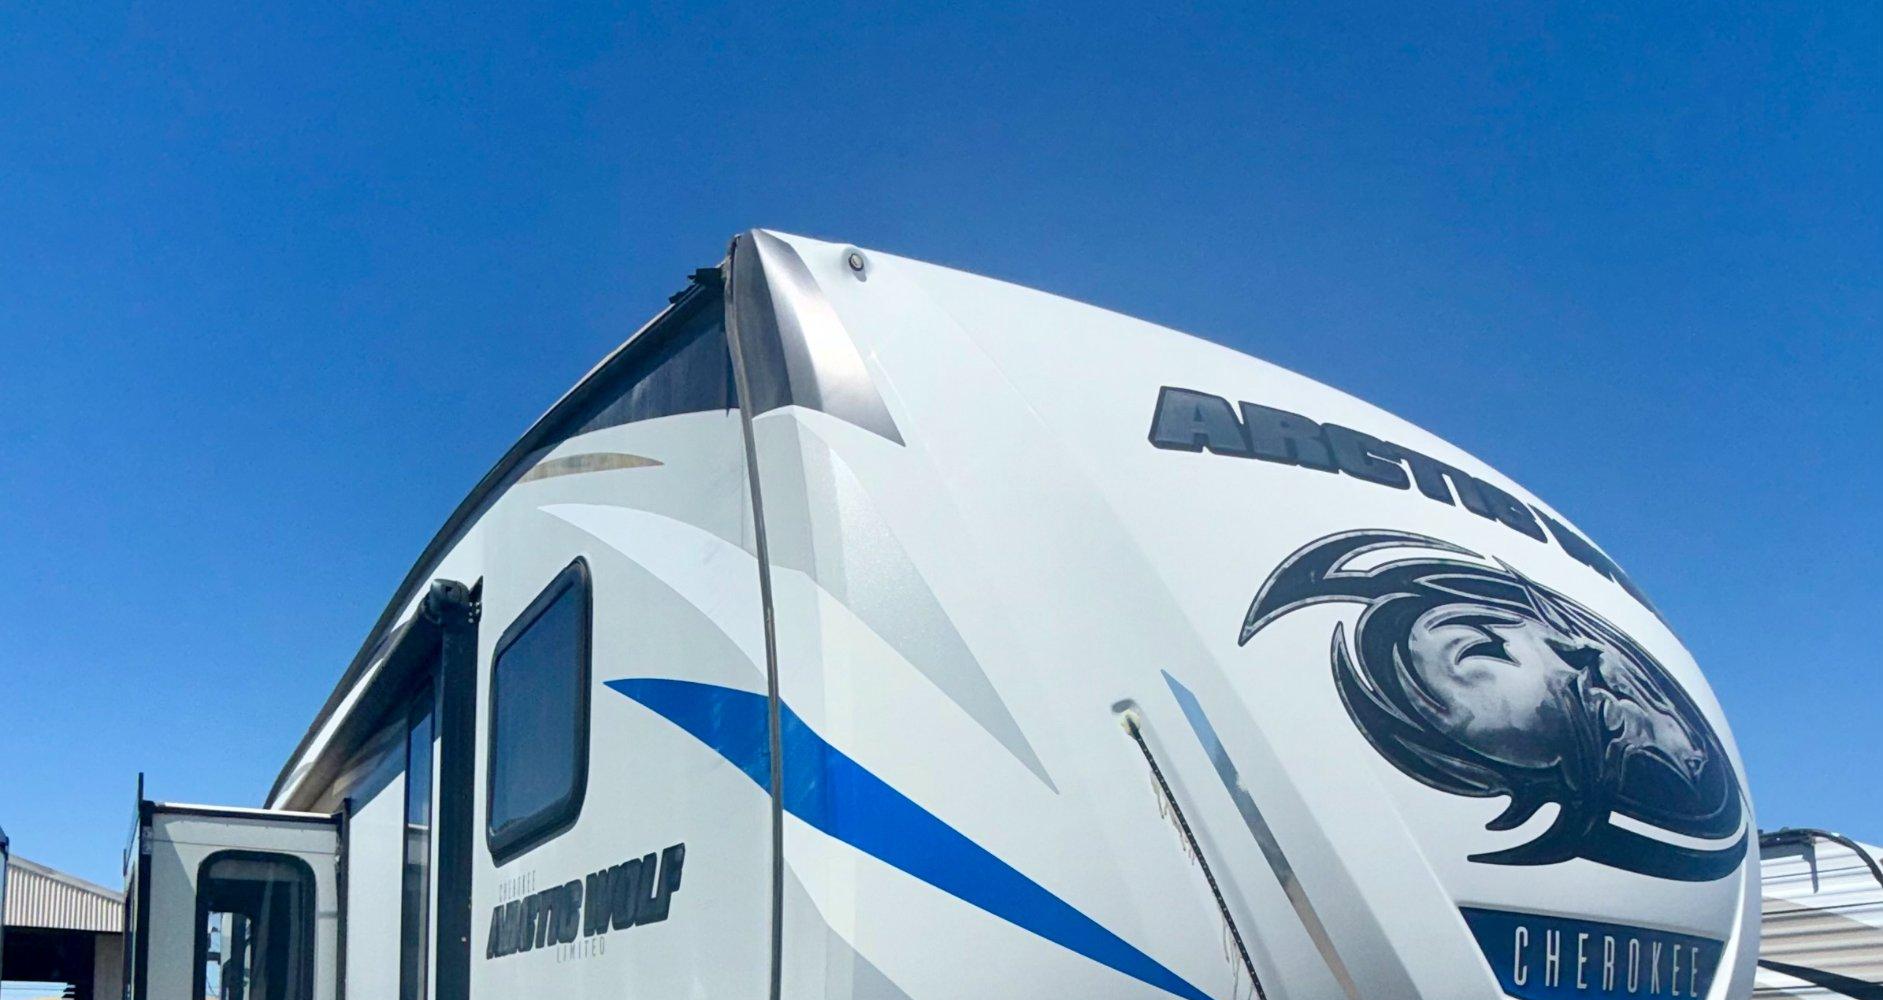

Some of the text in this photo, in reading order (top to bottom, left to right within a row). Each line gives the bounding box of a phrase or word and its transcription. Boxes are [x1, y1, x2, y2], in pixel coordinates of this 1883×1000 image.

[1147, 384, 1548, 544] ARCTIC
[583, 842, 686, 938] WOLF
[556, 936, 606, 964] LIMITED
[1513, 925, 1699, 998] CHEROKEE
